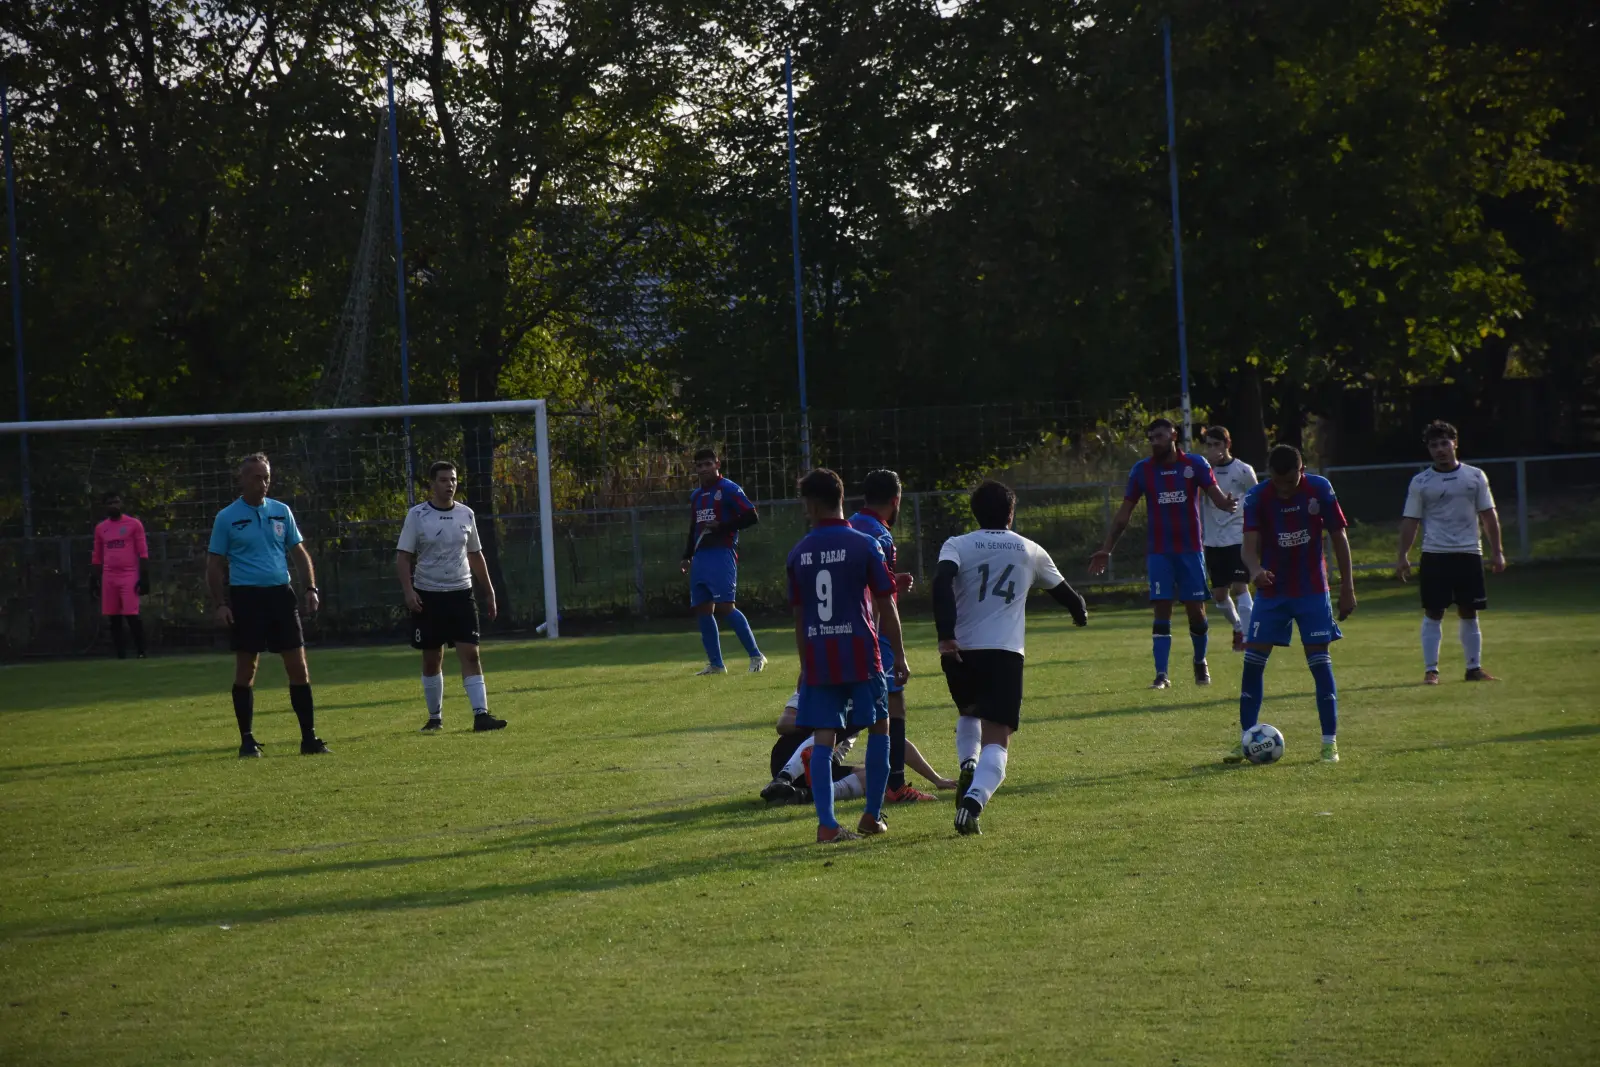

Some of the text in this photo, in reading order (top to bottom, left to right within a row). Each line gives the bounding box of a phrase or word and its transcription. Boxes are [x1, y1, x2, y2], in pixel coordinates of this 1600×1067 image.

[976, 541, 1025, 552] NK SENKOVEC
[800, 549, 846, 565] NK PARAG
[978, 564, 1016, 604] 14
[815, 569, 833, 622] 9
[415, 628, 421, 642] 8
[1253, 621, 1261, 638] 7
